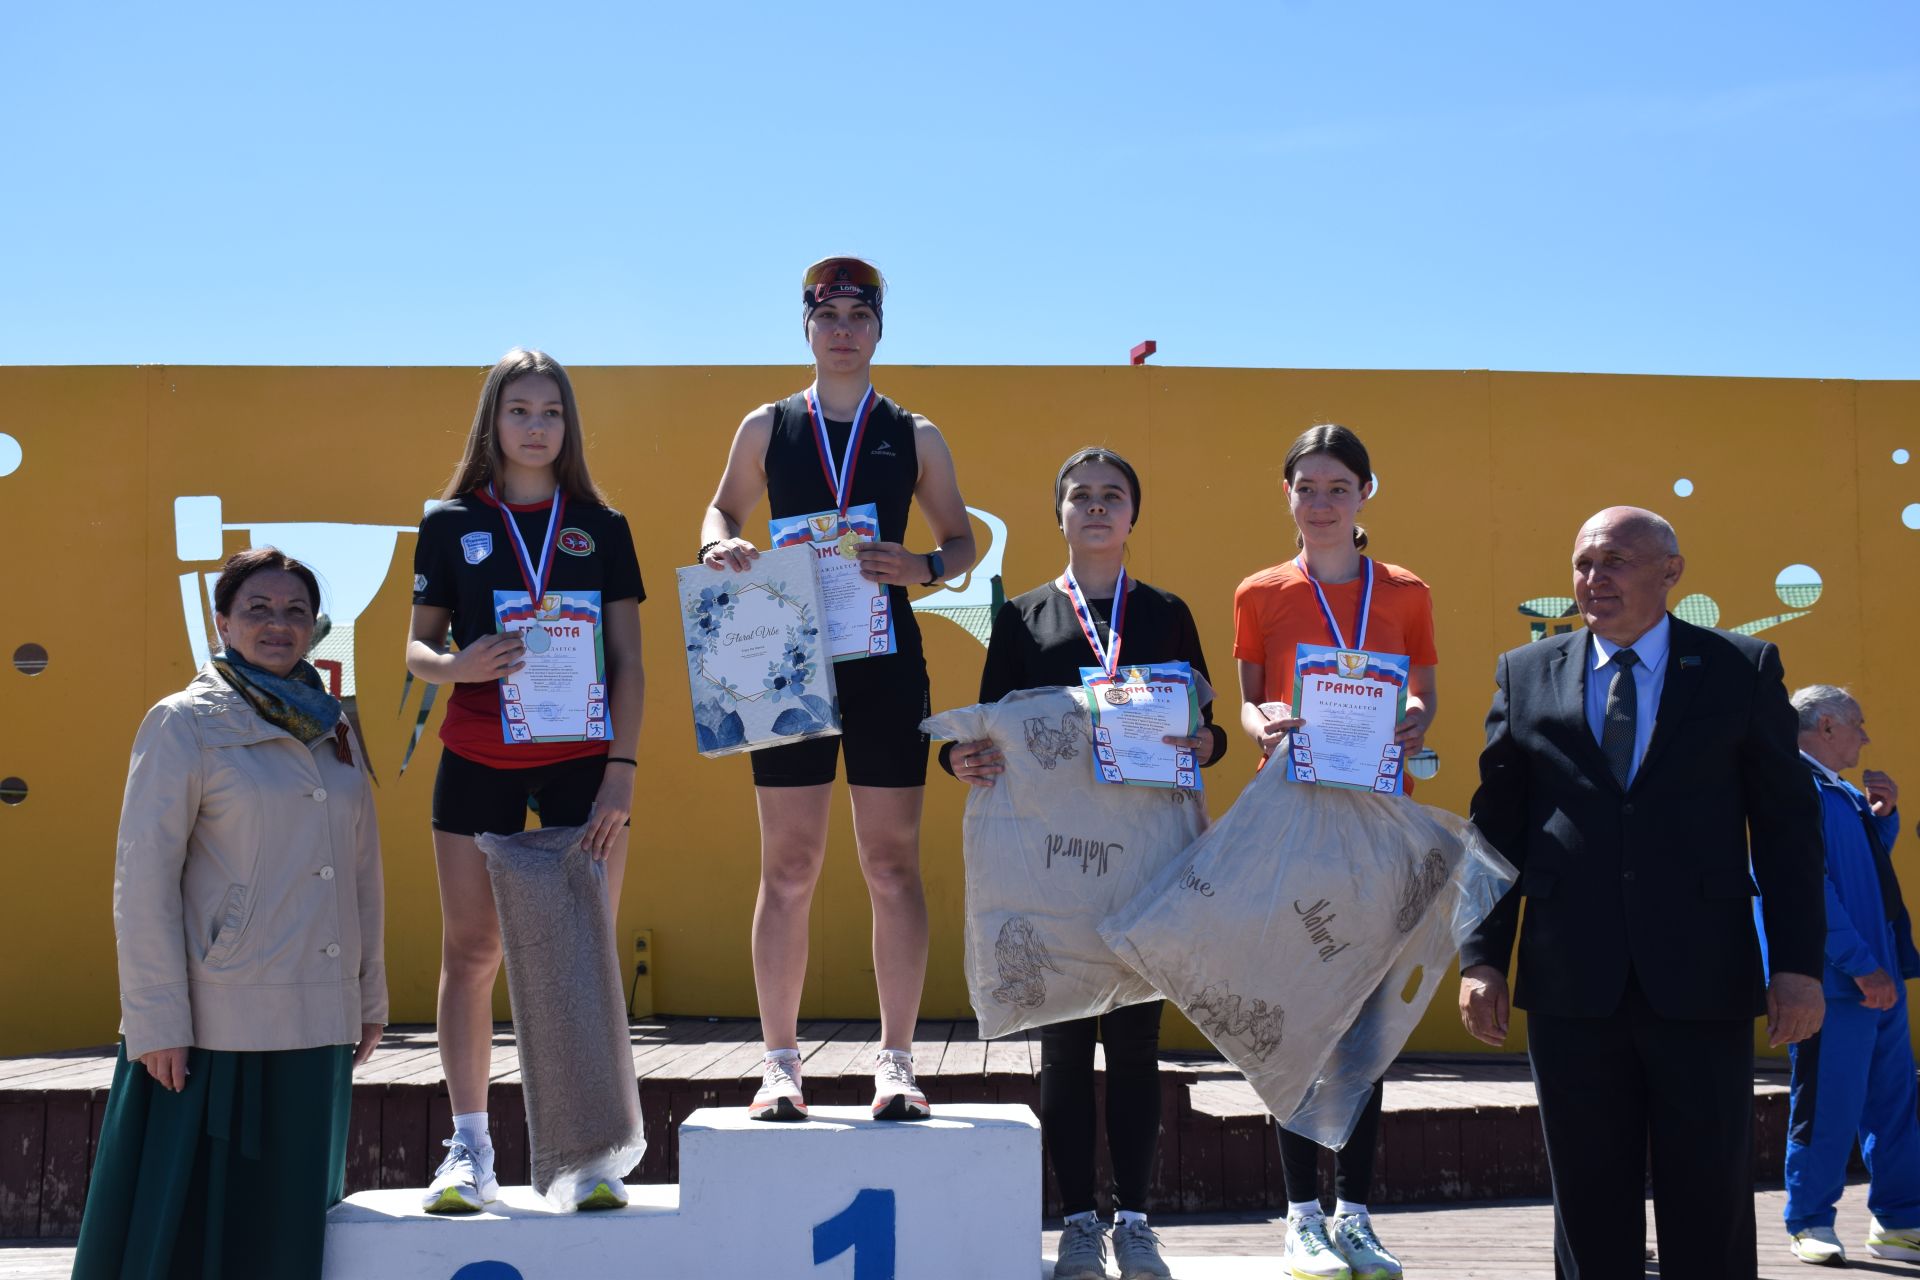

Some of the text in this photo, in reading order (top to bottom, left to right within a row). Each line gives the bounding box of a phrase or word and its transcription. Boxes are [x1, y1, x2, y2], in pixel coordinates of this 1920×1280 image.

[723, 625, 779, 646] Floral Vibe
[1119, 686, 1173, 694] АМОТА
[1317, 680, 1383, 698] ГРАМОТА
[1319, 700, 1377, 711] НАГРАЖДАЕТСЯ
[1044, 834, 1123, 877] Natural
[1294, 899, 1351, 962] Natural
[813, 1188, 896, 1280] 1
